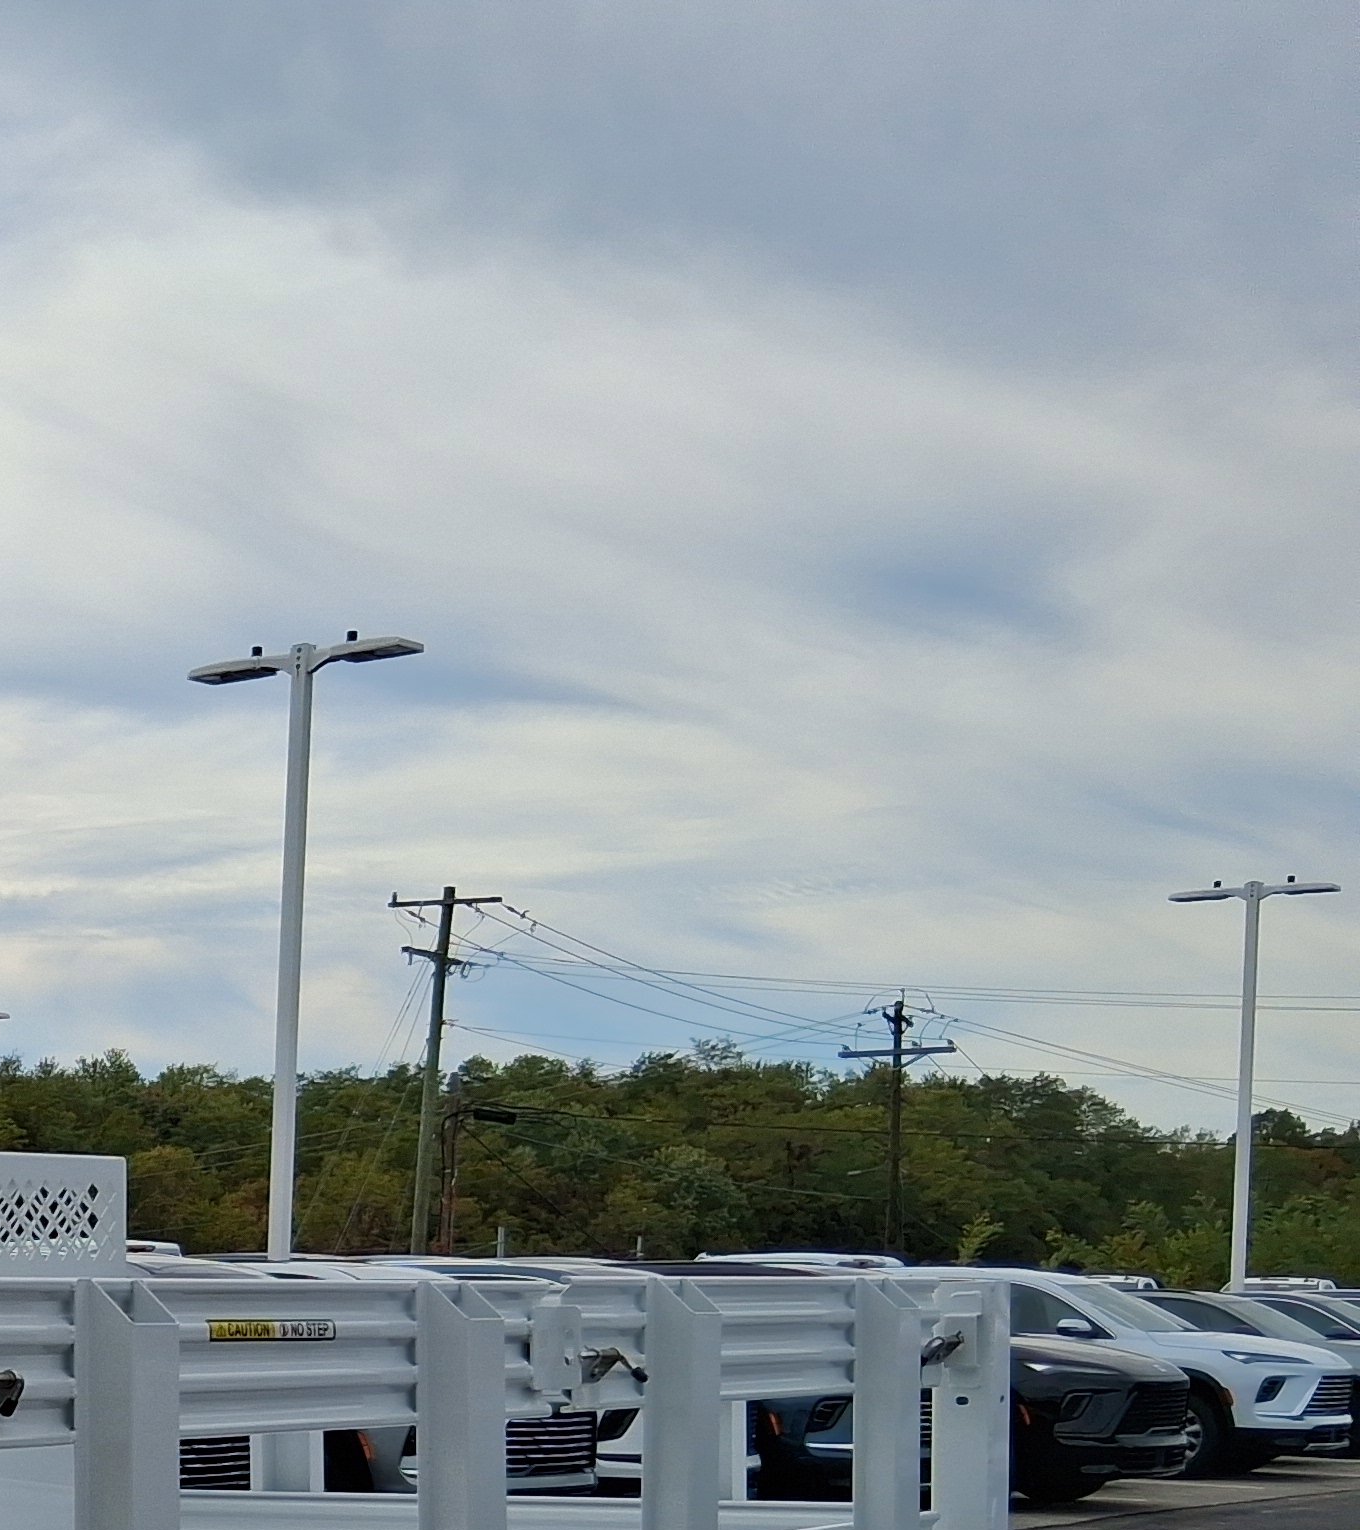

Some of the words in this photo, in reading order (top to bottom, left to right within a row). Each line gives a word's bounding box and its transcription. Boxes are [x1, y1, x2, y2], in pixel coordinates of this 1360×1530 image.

[227, 1323, 270, 1337] CAUTION
[291, 1323, 304, 1337] NO
[306, 1323, 329, 1337] STEP
